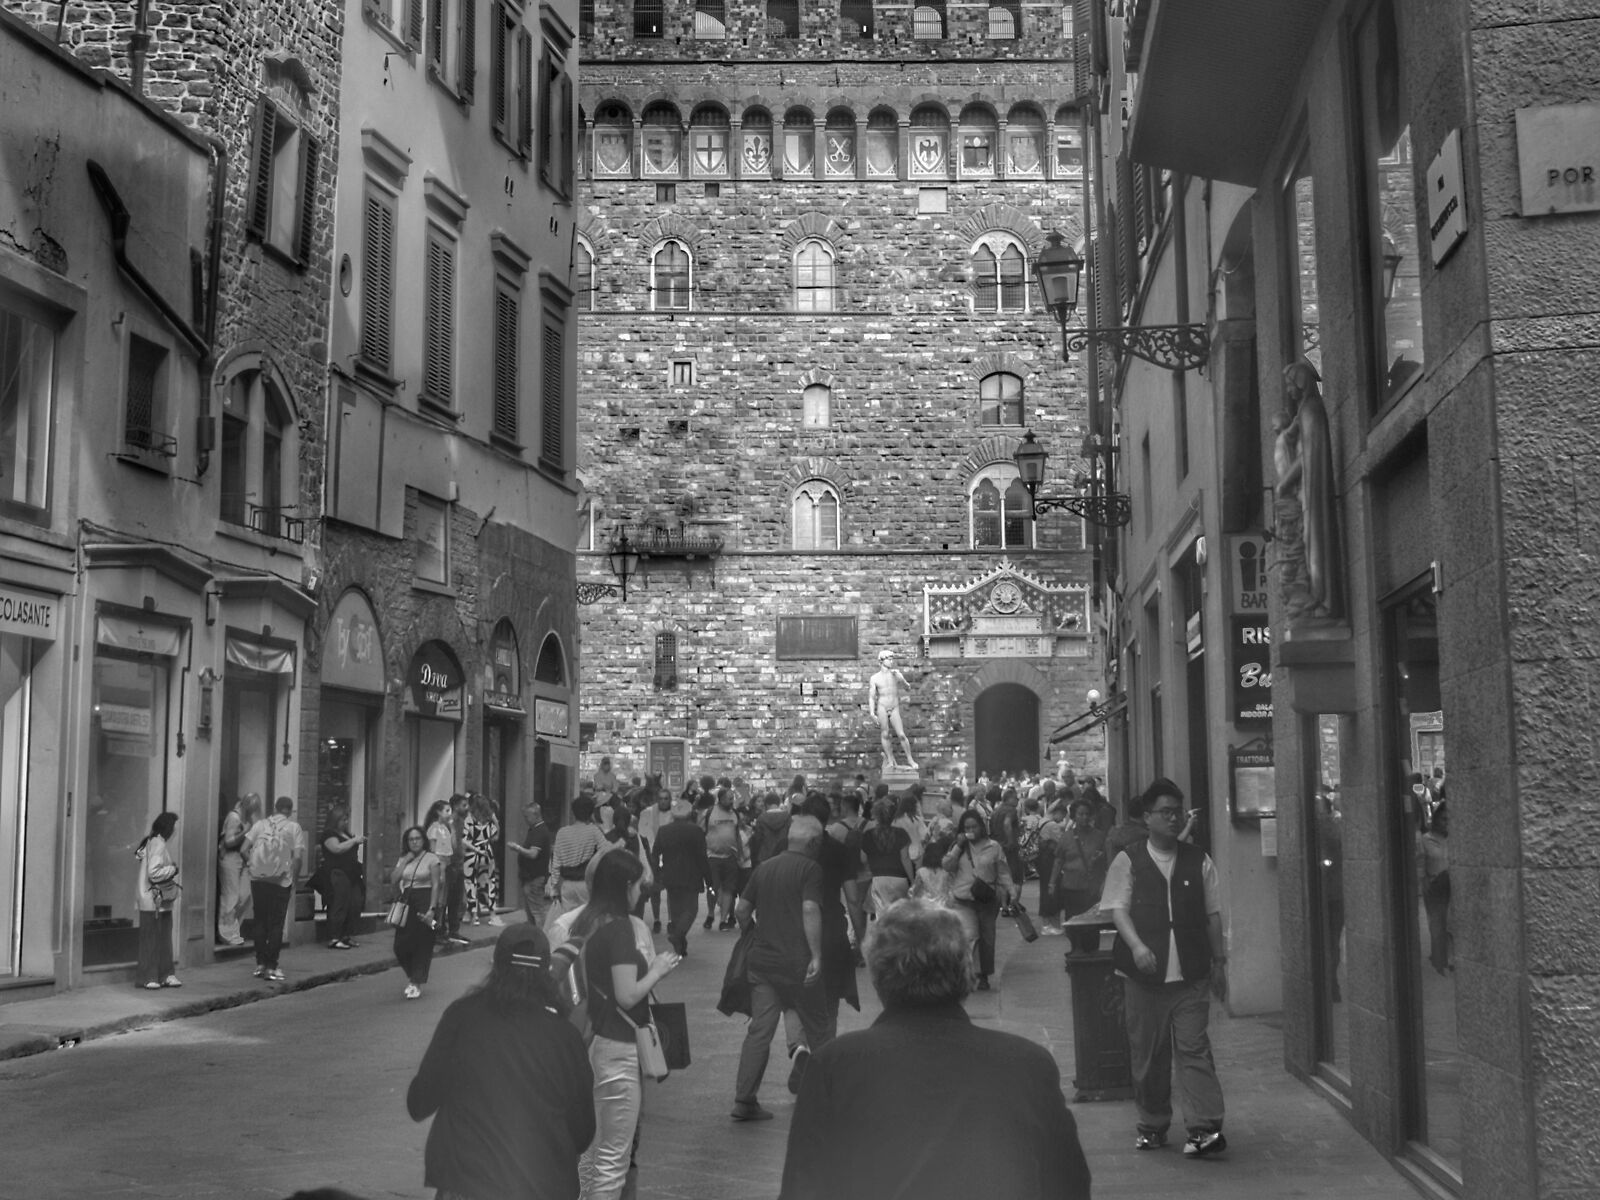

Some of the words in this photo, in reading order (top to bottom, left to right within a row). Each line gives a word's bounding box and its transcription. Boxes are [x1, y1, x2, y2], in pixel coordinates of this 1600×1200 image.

[1547, 166, 1596, 187] POR
[1241, 593, 1268, 609] BAR
[1236, 755, 1270, 764] TRATTORIA
